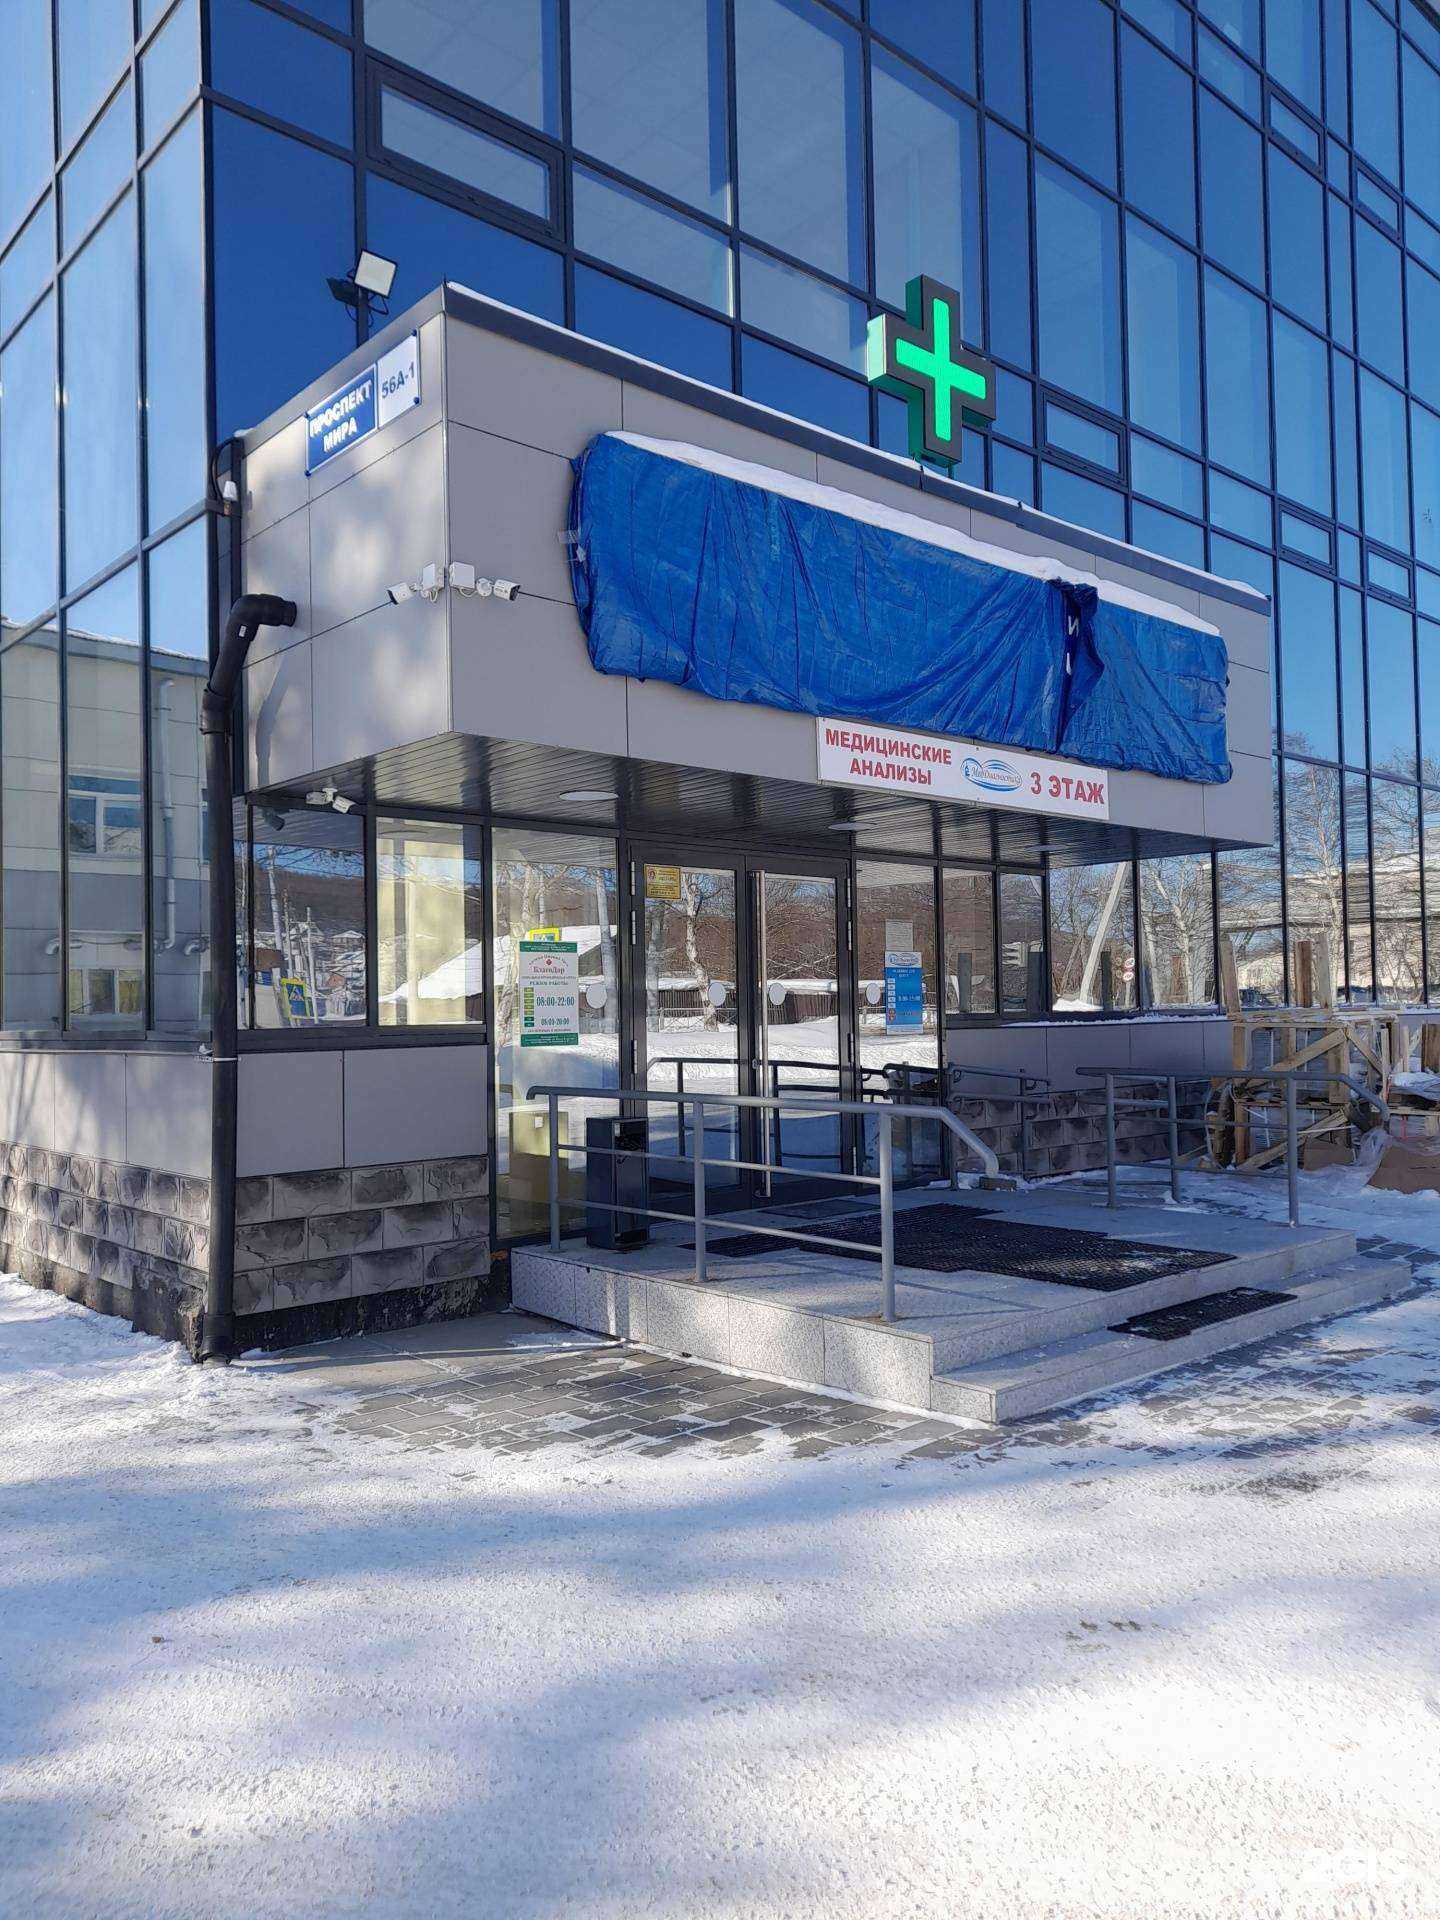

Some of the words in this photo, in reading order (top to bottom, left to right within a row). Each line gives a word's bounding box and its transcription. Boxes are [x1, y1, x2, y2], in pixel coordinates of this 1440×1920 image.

[309, 379, 373, 438] ПРОСПЕКТ
[323, 417, 358, 453] МИРА
[825, 728, 952, 766] МЕДИЦИНСКИЕ
[849, 758, 932, 786] АНАЛИЗЫ
[1030, 772, 1042, 795] 3
[1048, 775, 1105, 804] ЭТАЖ
